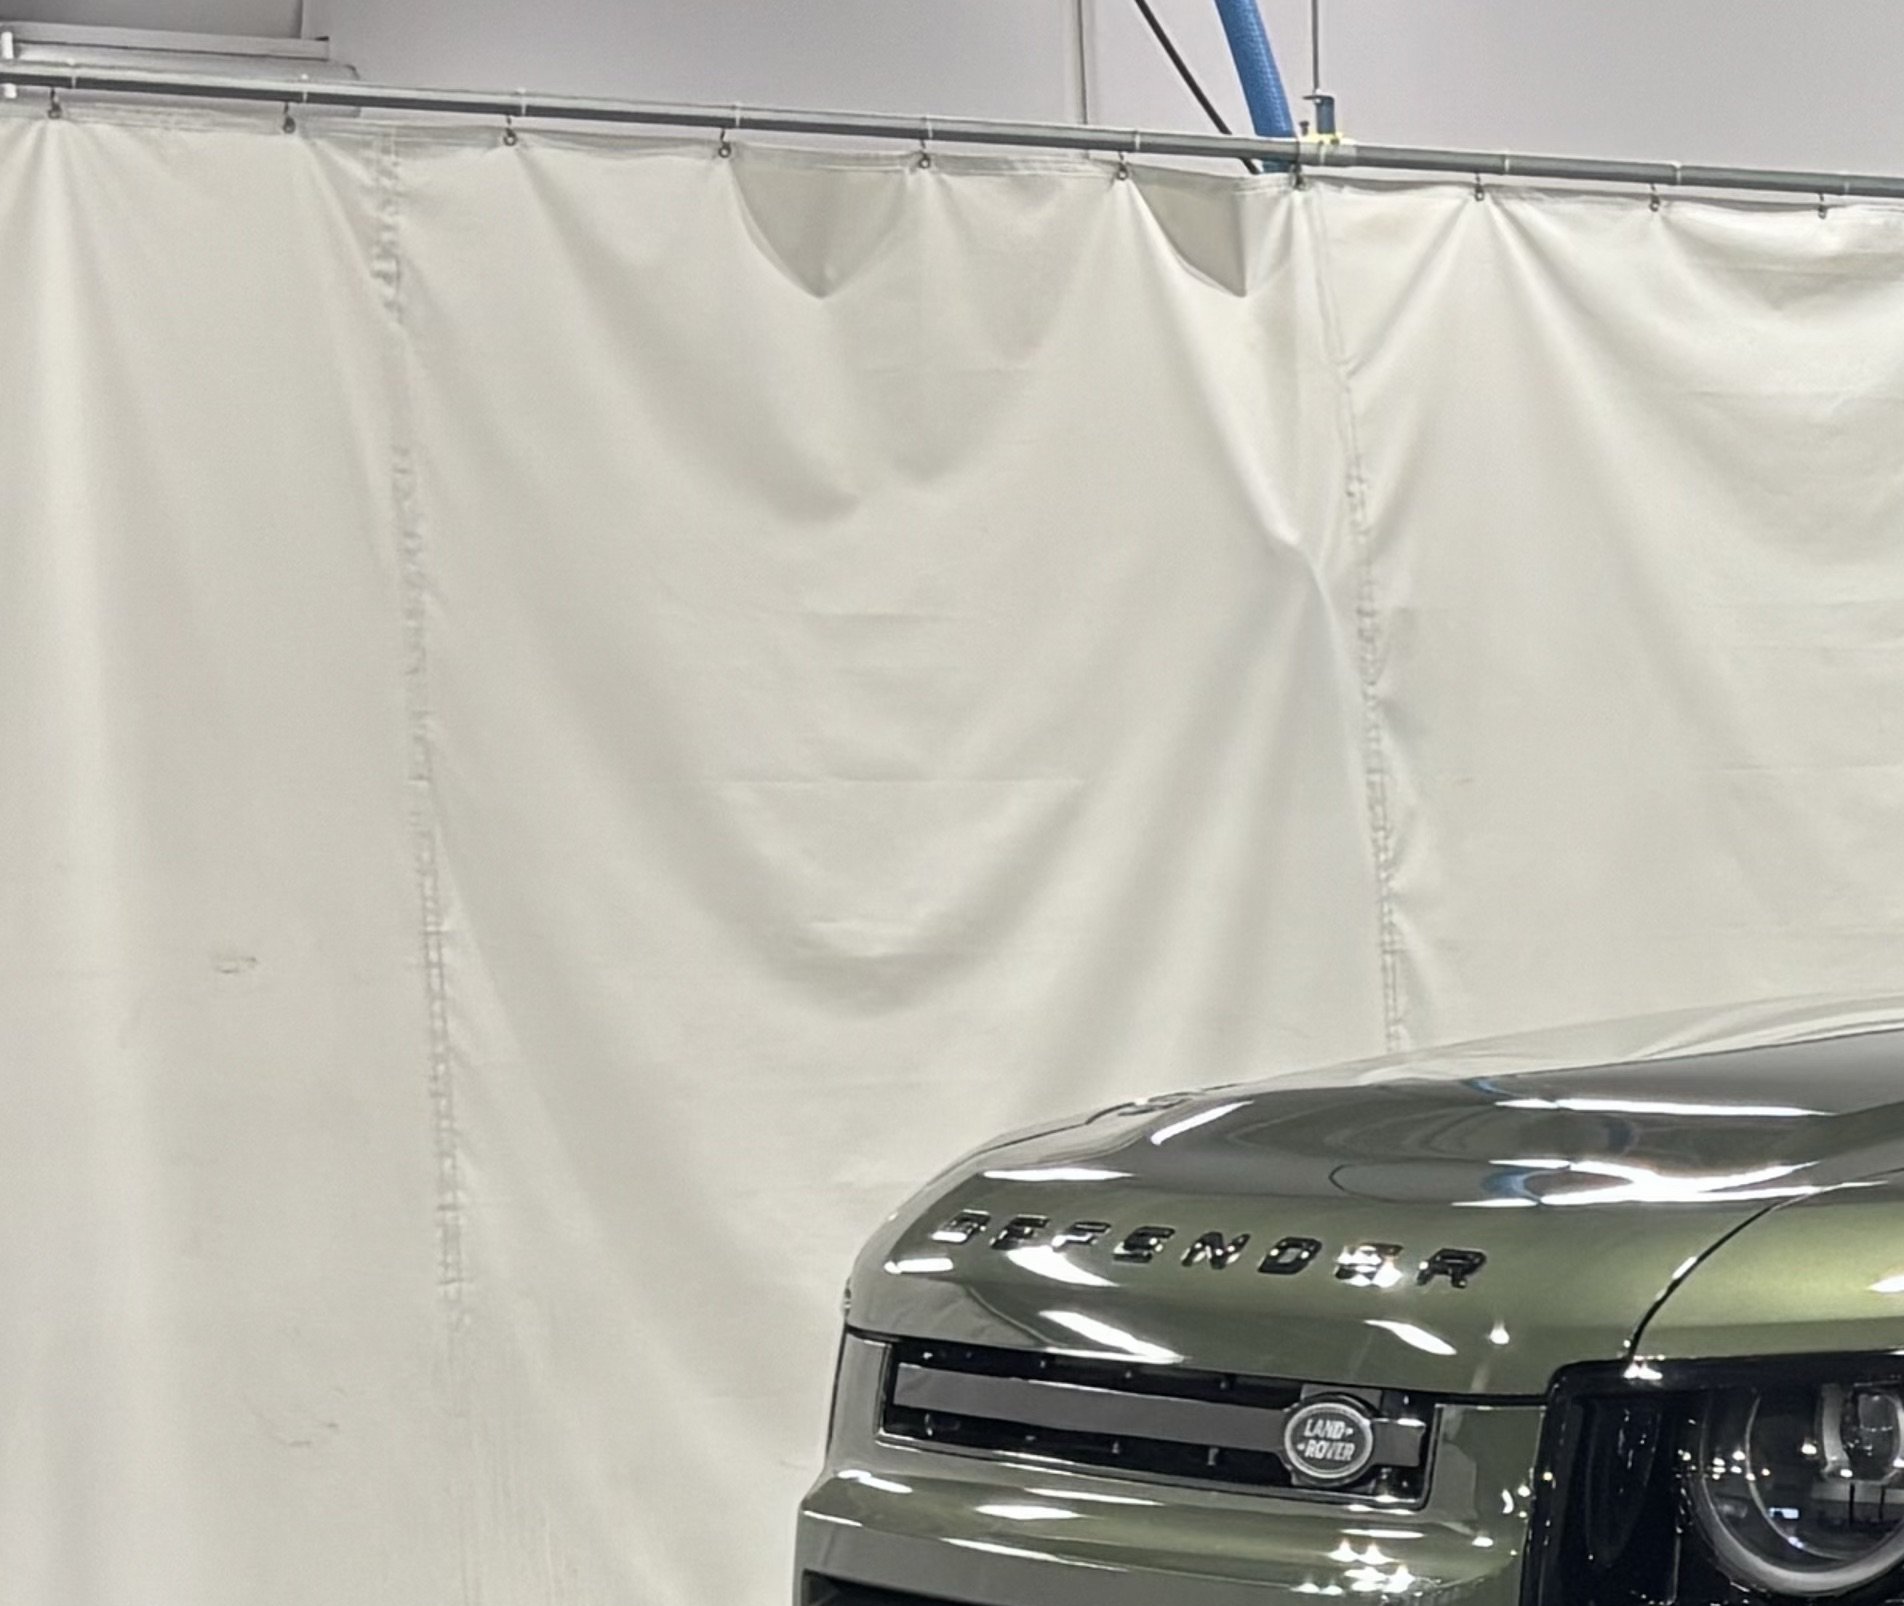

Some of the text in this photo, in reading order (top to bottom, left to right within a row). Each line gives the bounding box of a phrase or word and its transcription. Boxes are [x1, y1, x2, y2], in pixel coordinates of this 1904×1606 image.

[930, 1208, 1487, 1289] DEFENDER
[1303, 1418, 1346, 1440] LAND
[1304, 1439, 1356, 1461] ROVER
